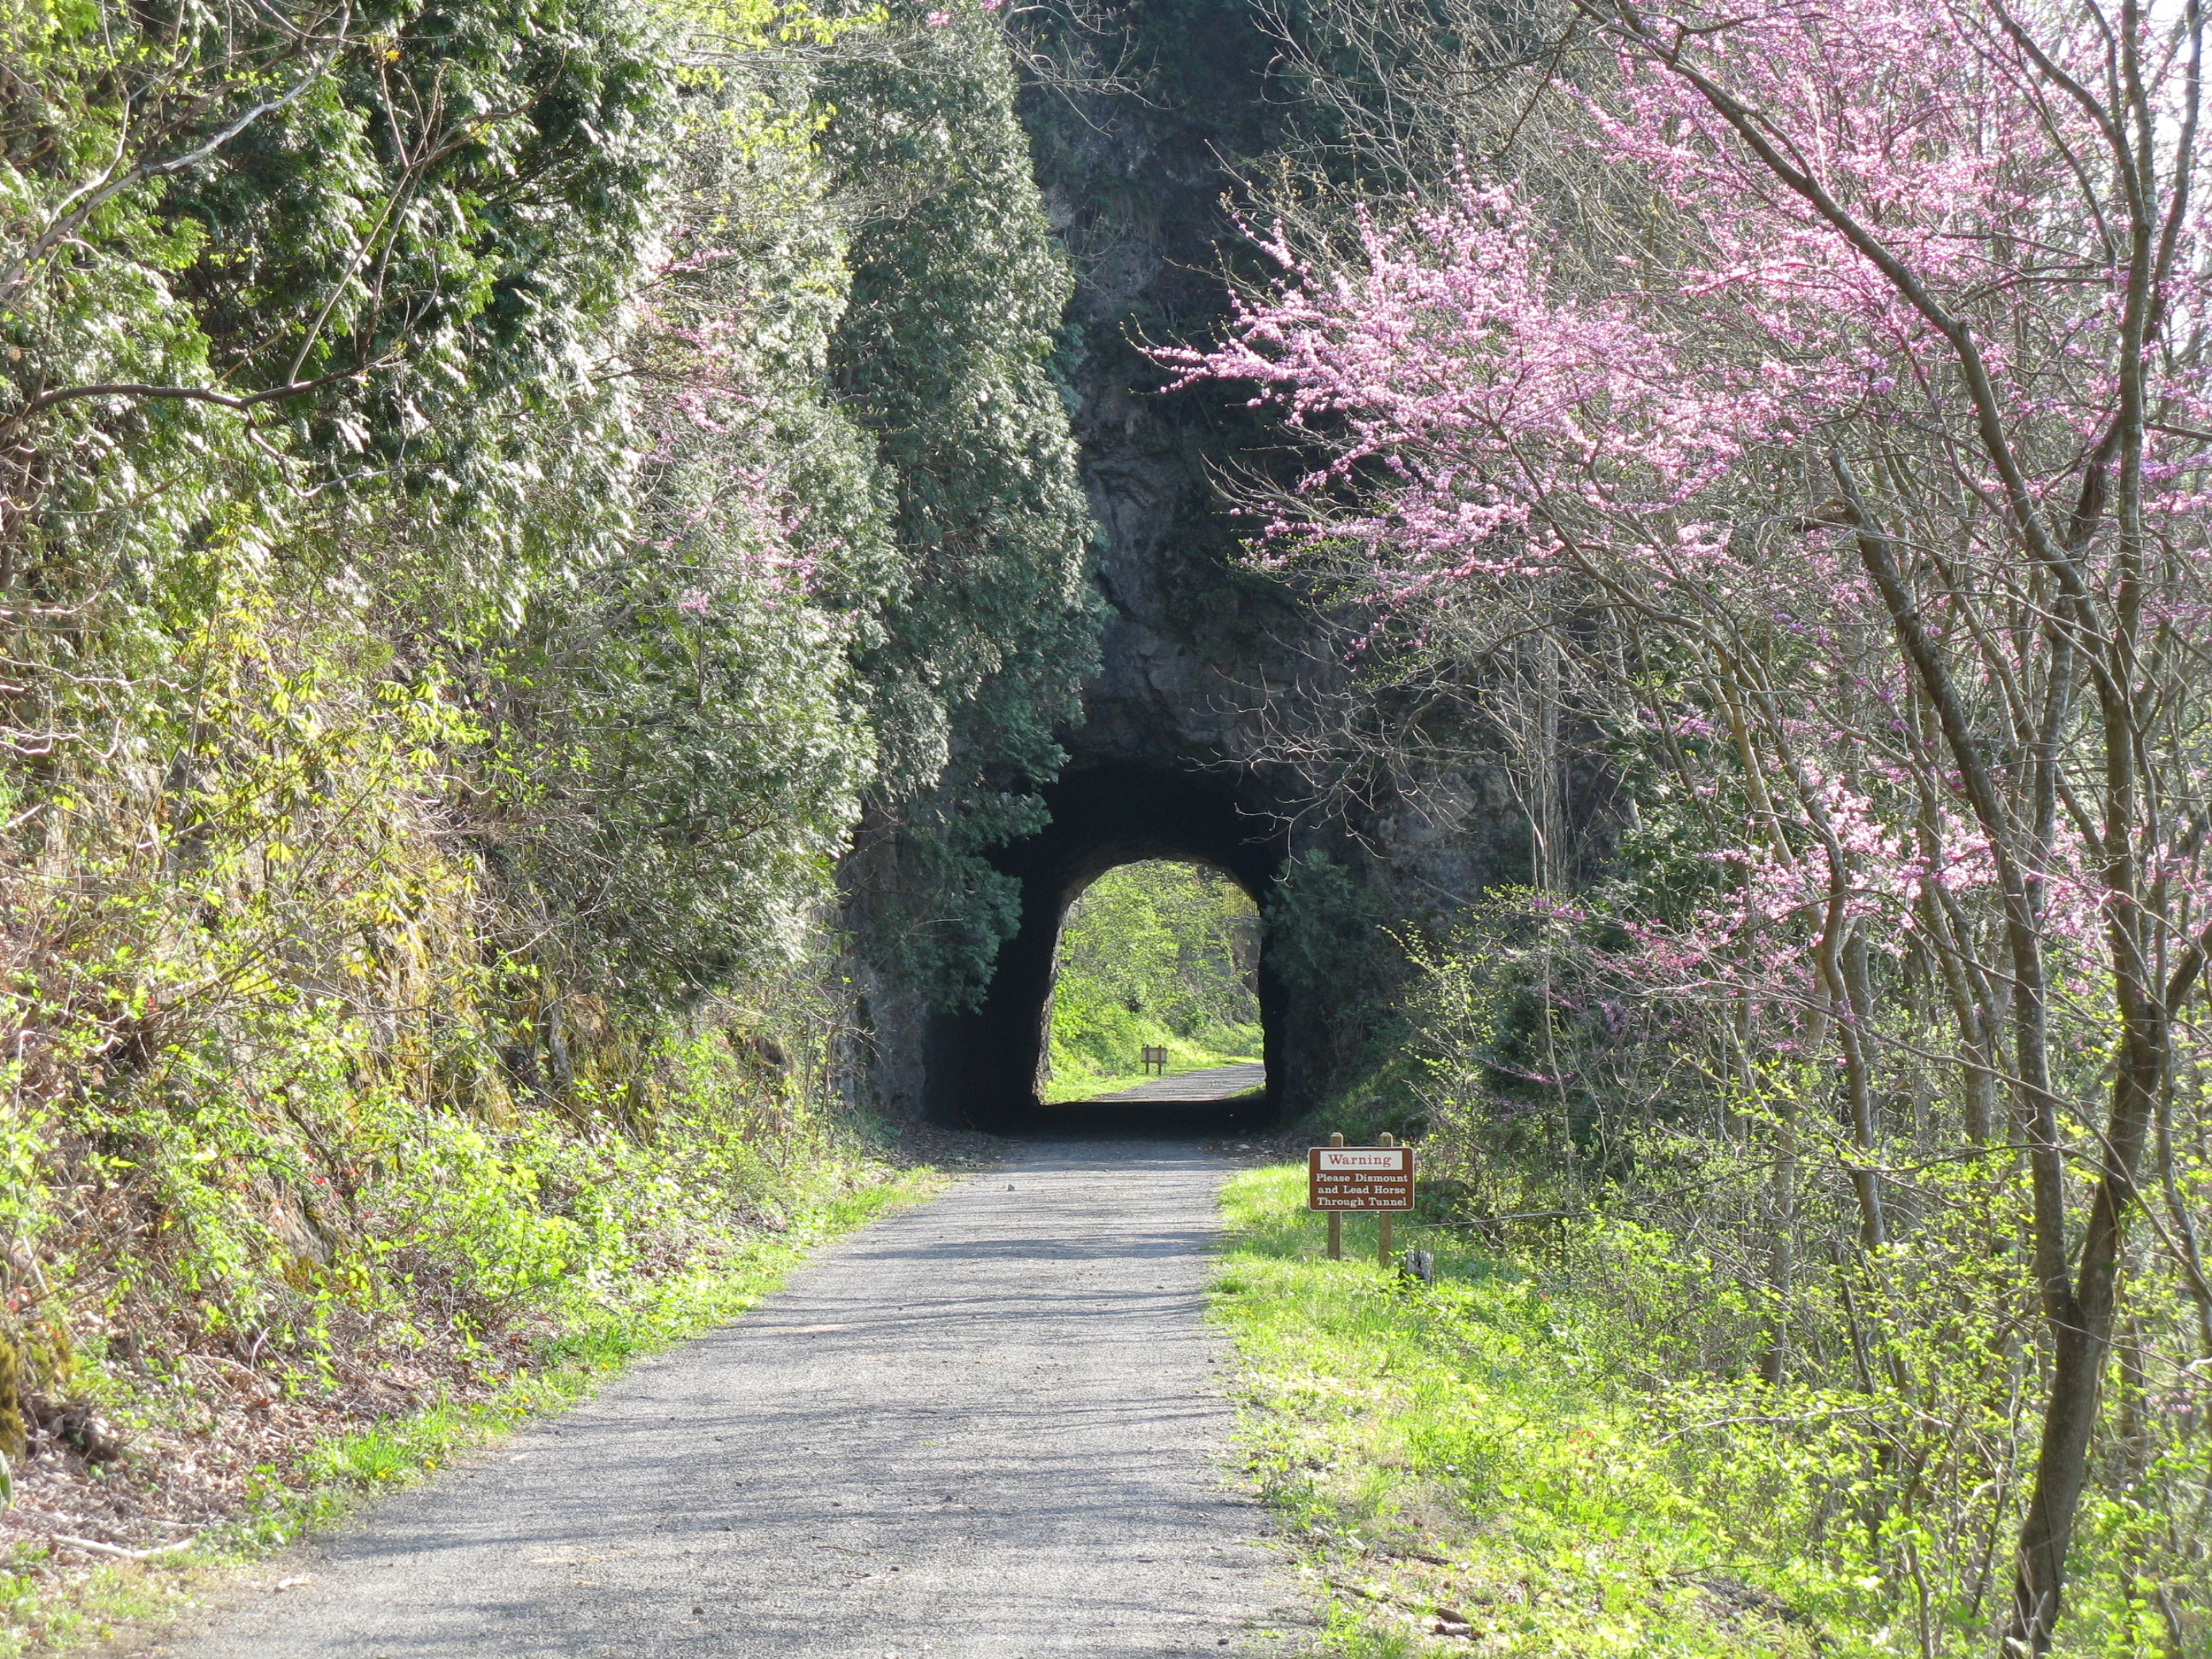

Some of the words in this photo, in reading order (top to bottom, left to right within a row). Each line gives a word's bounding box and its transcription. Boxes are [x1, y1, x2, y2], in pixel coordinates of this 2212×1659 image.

[1328, 1154, 1392, 1167] Warning
[1316, 1173, 1351, 1182] Please
[1354, 1173, 1408, 1182] Dismount
[1318, 1185, 1338, 1194] and
[1343, 1185, 1370, 1194] Lead
[1374, 1185, 1406, 1194] Horse
[1317, 1196, 1365, 1208] Through
[1368, 1196, 1407, 1206] Tunnel
